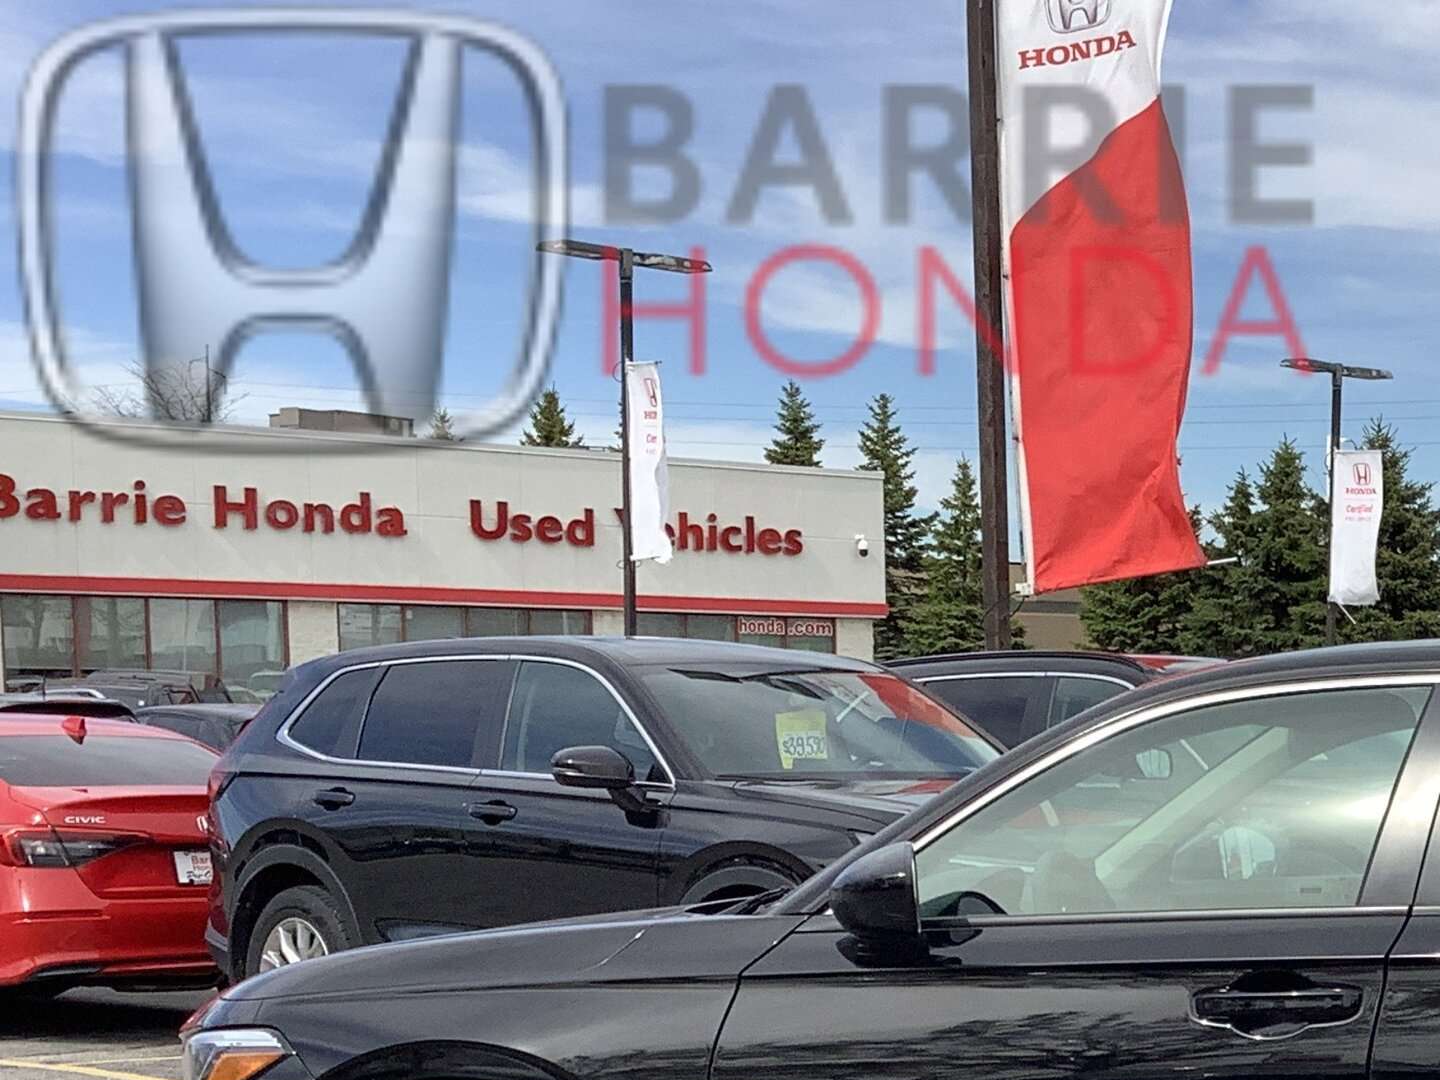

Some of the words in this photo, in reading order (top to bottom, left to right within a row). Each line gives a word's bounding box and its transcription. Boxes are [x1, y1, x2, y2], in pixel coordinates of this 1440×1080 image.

[1018, 30, 1136, 69] HONDA
[212, 484, 408, 536] Honda
[469, 499, 595, 547] Used
[614, 508, 803, 556] hicles
[64, 815, 107, 824] CIVIC
